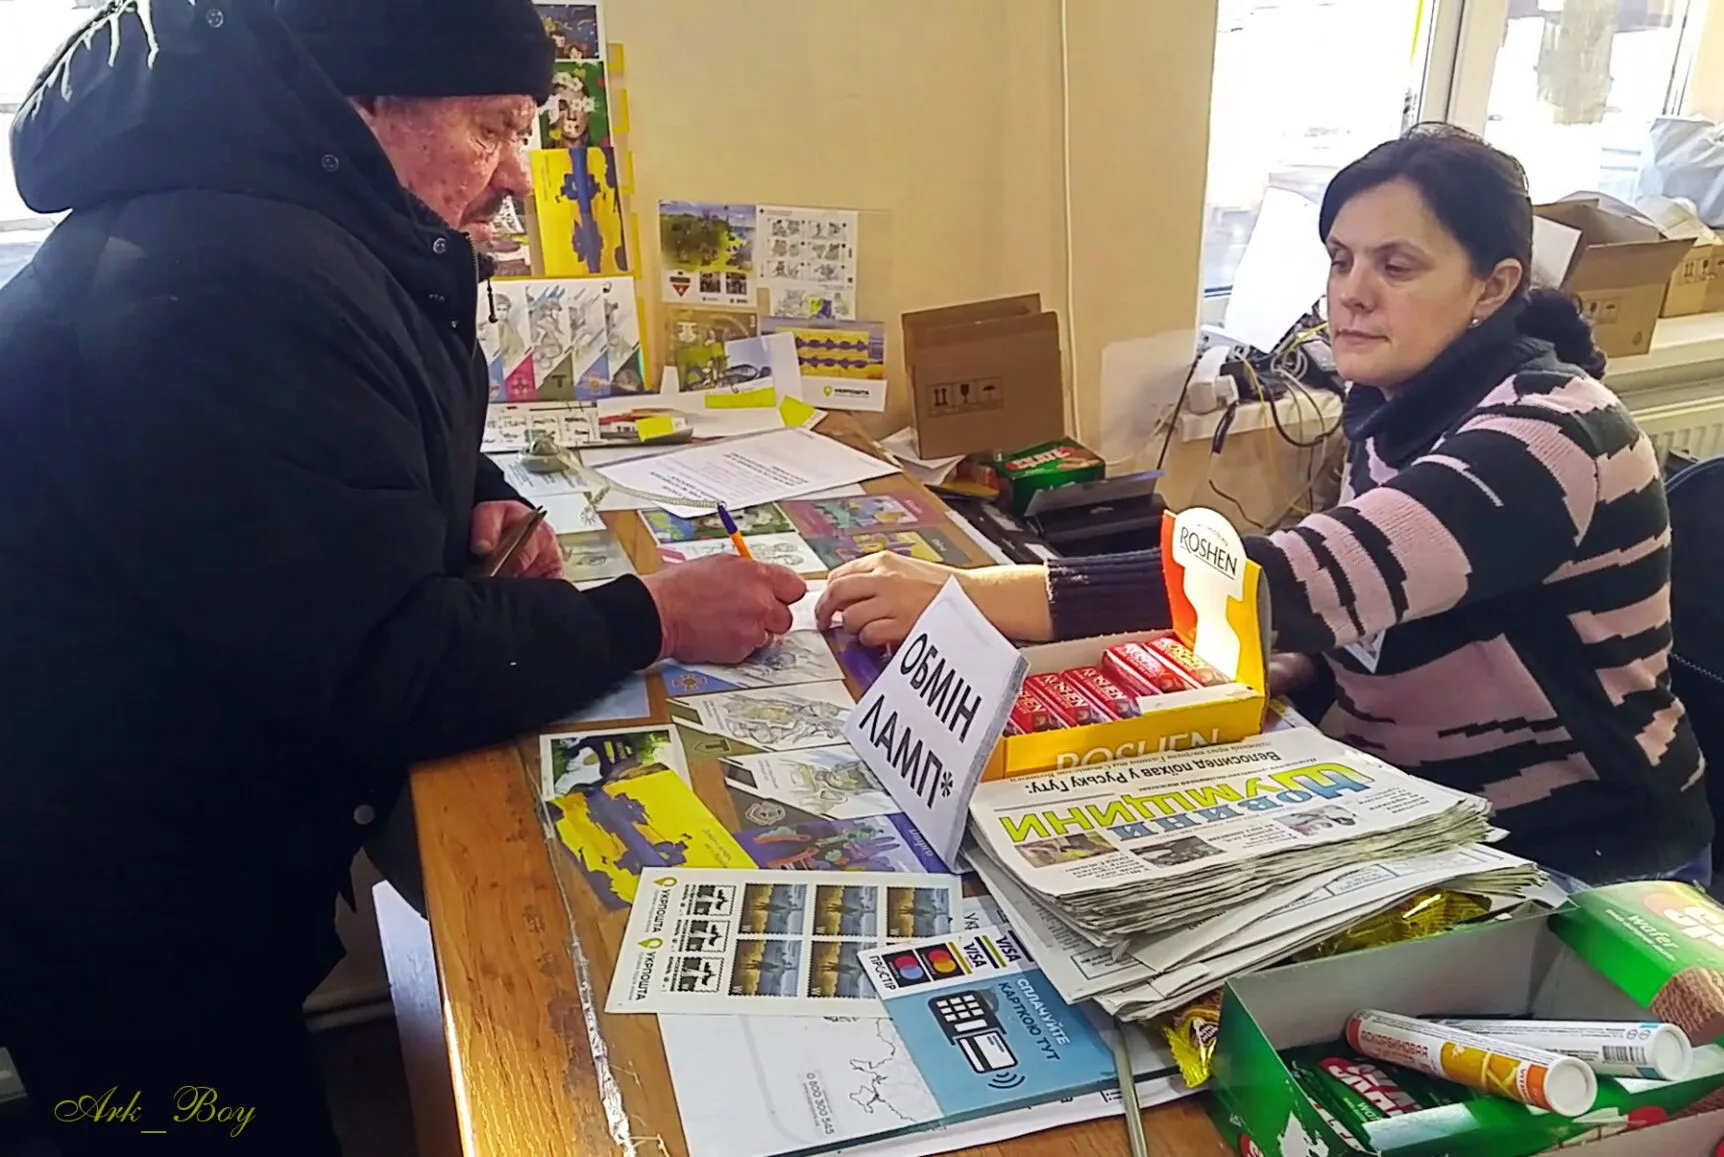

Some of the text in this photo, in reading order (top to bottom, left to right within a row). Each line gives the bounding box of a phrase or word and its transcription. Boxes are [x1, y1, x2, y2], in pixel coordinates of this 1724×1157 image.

[1179, 526, 1239, 575] ROSHEN
[900, 633, 982, 743] ОБМІН
[1141, 759, 1192, 779] поїхав
[1193, 749, 1281, 771] Велосипед
[1024, 777, 1069, 797] Гуту:
[1070, 769, 1128, 790] Руську
[653, 889, 670, 933] УКРПОШТА
[1627, 913, 1678, 950] wafer
[965, 943, 985, 968] VISA
[996, 937, 1020, 962] VISA
[636, 953, 657, 1001] УКРПОШТА
[870, 956, 897, 990] ПРОСТІР
[998, 982, 1061, 1060] КАРТКОЮ ТУТ
[1017, 977, 1070, 1044] СПЛАЧУЙТЕ
[808, 1080, 823, 1098] 800
[814, 1098, 829, 1117] 300
[821, 1117, 836, 1136] 545
